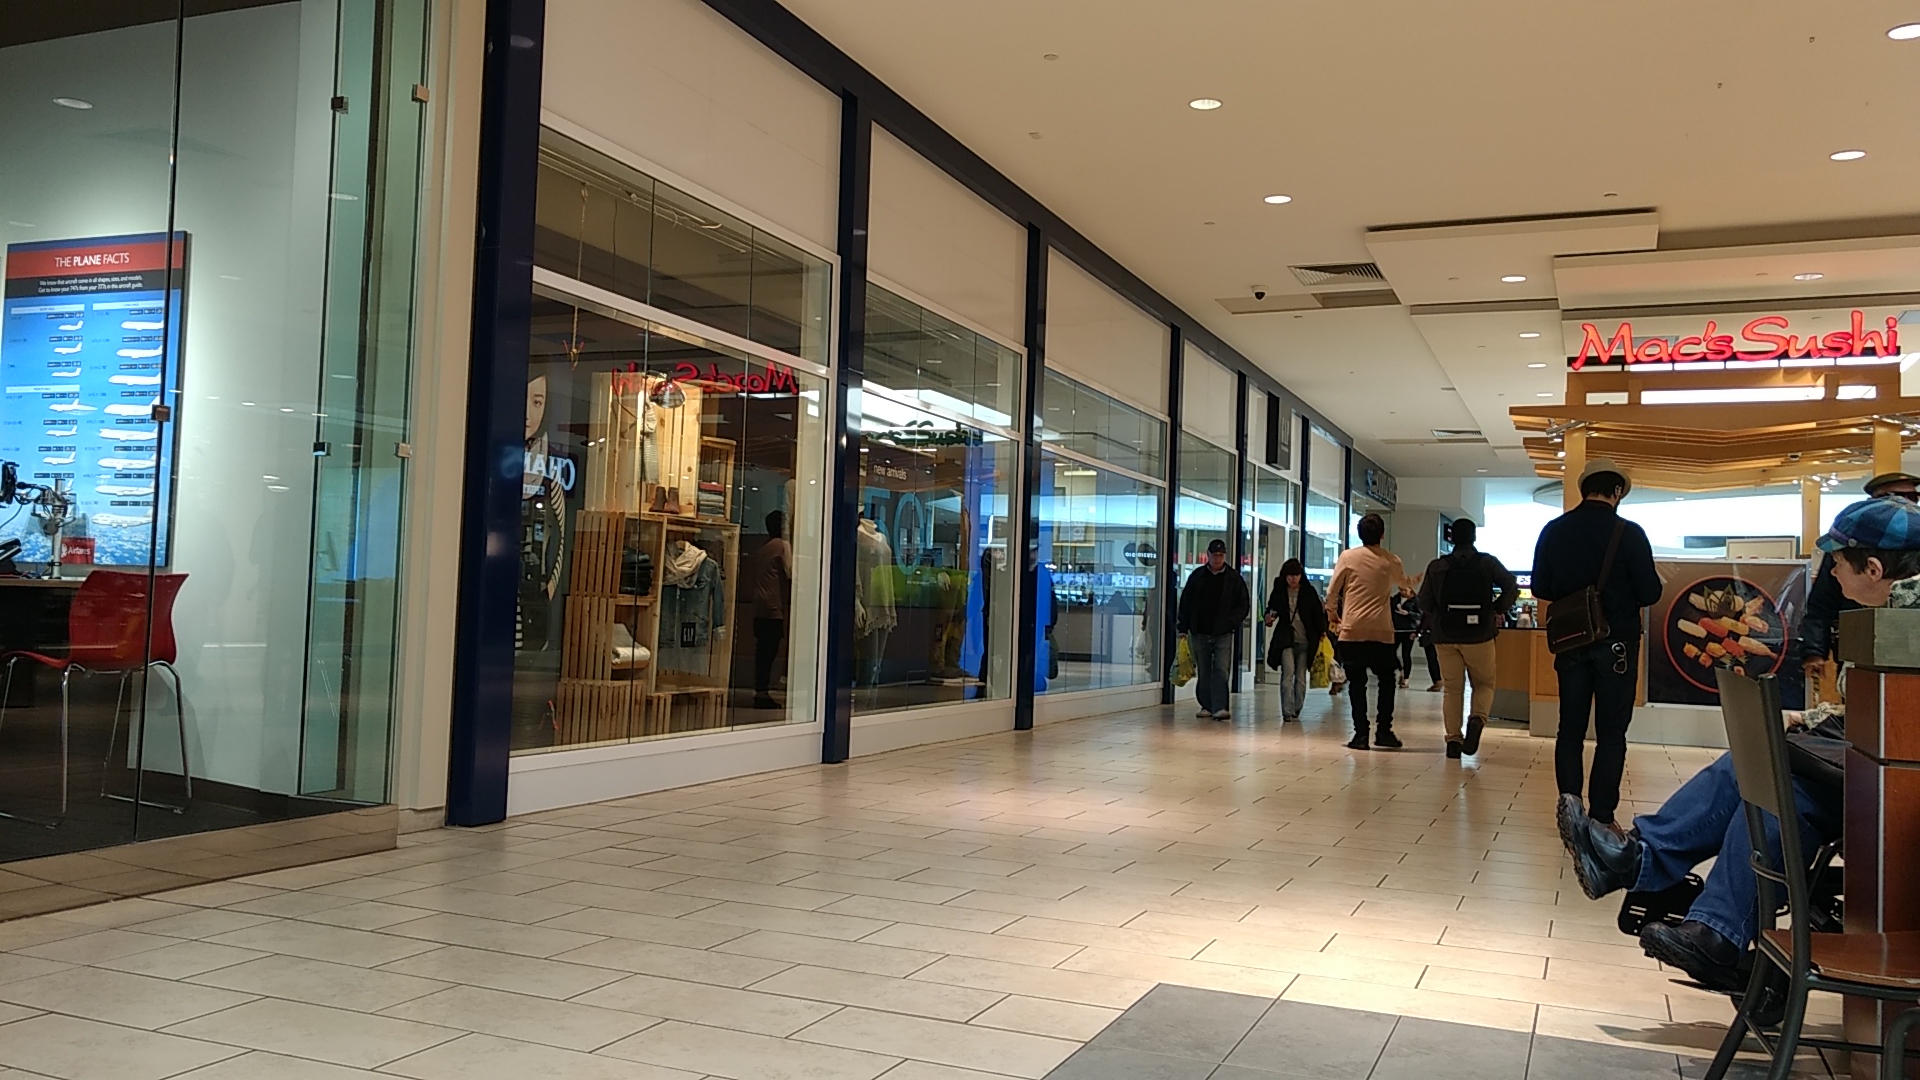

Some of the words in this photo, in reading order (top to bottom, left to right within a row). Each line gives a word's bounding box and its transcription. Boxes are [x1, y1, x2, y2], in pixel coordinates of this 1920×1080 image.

[54, 256, 72, 268] THE
[72, 254, 102, 266] PLANE
[102, 252, 130, 264] FACTS
[1571, 320, 1735, 371] Mac's
[1735, 309, 1898, 362] Sushi
[873, 464, 887, 476] new
[886, 466, 907, 481] arrivals
